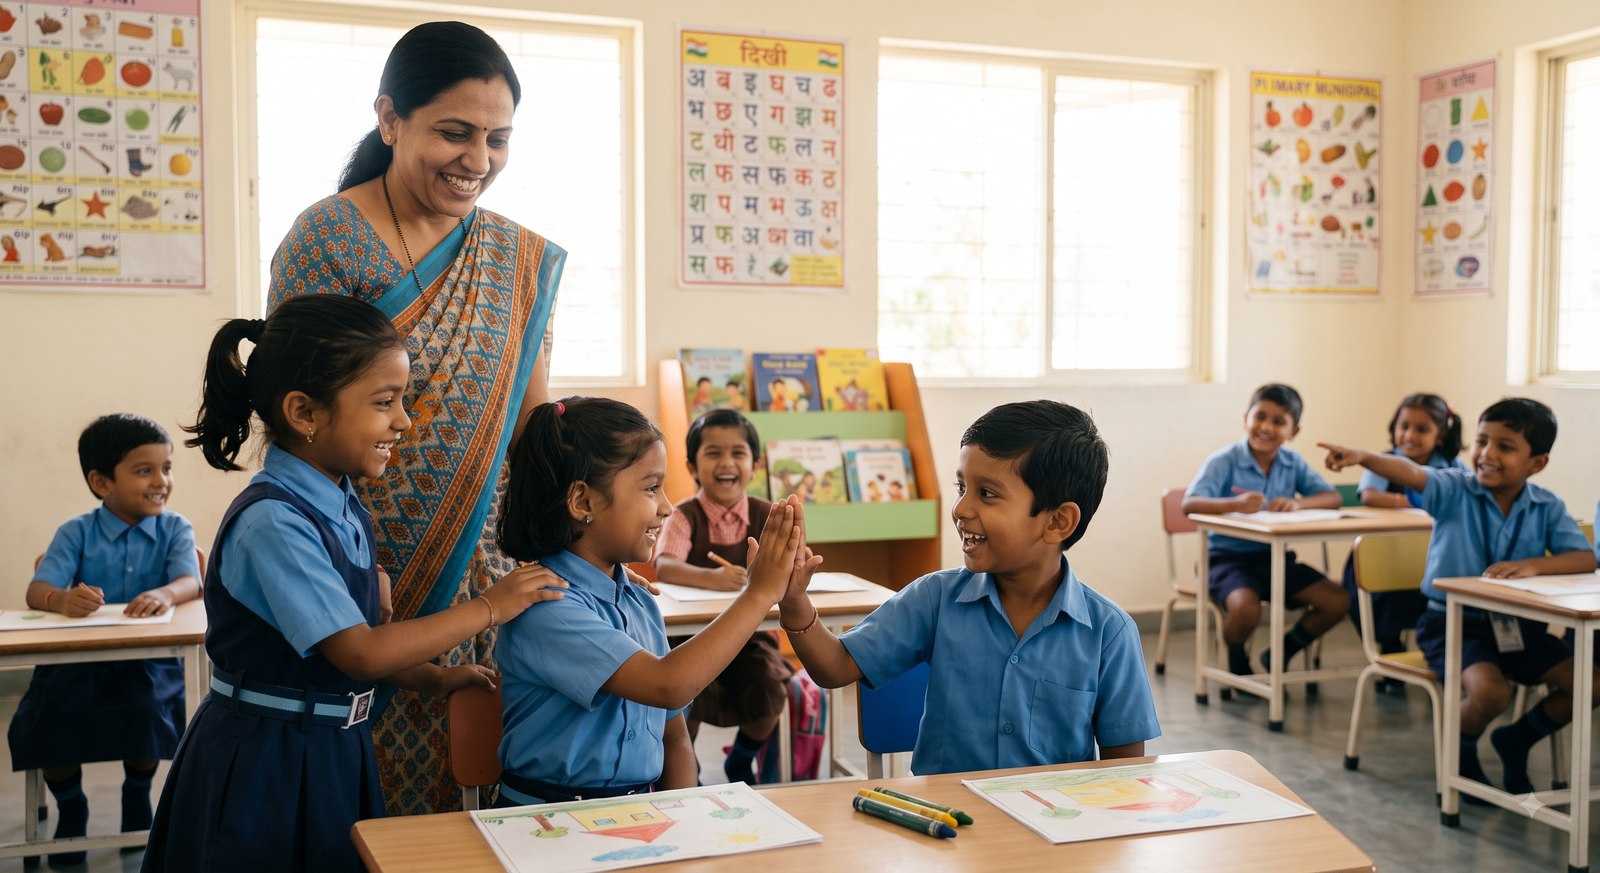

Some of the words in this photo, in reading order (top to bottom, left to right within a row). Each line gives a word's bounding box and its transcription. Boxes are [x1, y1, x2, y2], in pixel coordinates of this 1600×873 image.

[740, 39, 788, 67] दिखी
[688, 69, 706, 88] अ
[744, 73, 757, 95] इ
[795, 77, 811, 96] च
[688, 100, 705, 119] भ
[743, 104, 758, 127] ए
[770, 106, 784, 124] ग
[689, 131, 704, 151] ट
[744, 135, 758, 153] ट
[768, 136, 786, 154] फ
[795, 138, 812, 156] ल
[822, 140, 836, 158] न
[688, 162, 706, 181] ल
[715, 165, 733, 182] फ
[742, 166, 760, 184] स
[768, 167, 786, 185] फ
[795, 169, 812, 185] क
[717, 195, 731, 213] प
[744, 197, 758, 214] म
[715, 226, 733, 243] फ
[743, 227, 760, 244] अ
[689, 256, 706, 273] स
[715, 256, 733, 274] फ
